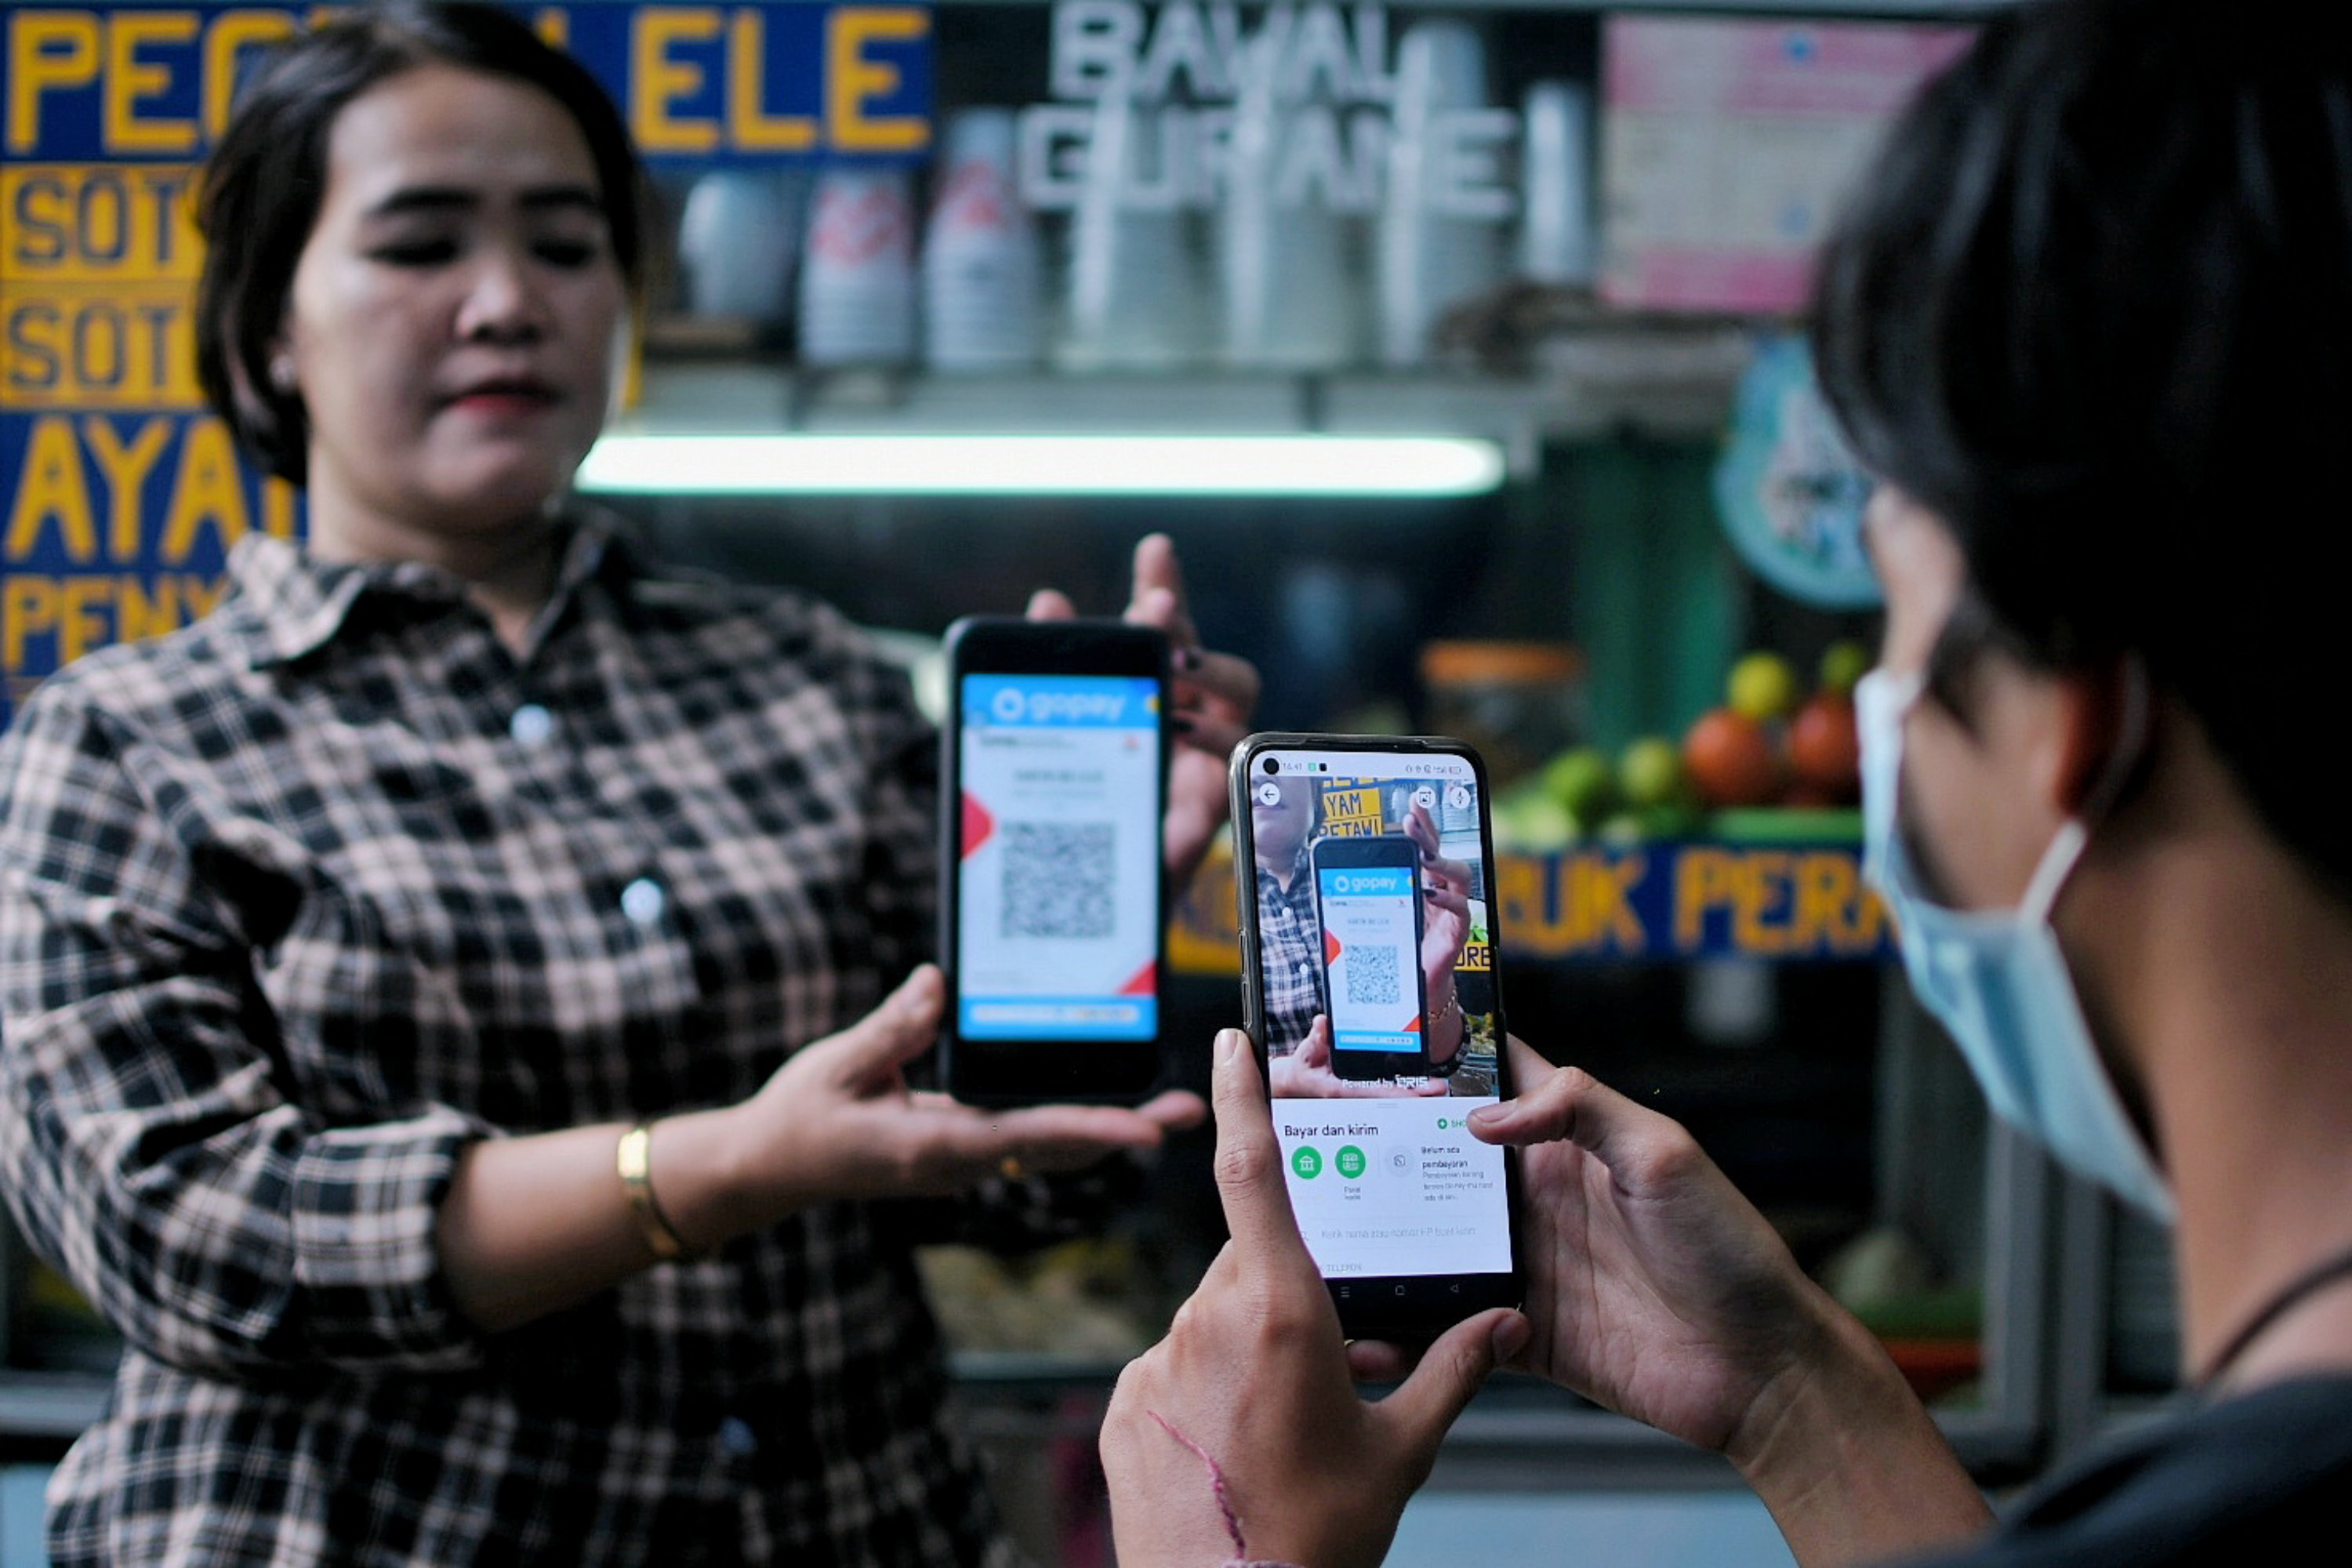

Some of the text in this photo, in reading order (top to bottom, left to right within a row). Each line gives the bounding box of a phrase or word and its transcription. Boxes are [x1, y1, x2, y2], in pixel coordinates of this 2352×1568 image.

[6, 8, 931, 152] PEC ELE
[12, 174, 194, 270] SOT
[8, 302, 185, 392] SOT
[2, 574, 231, 673] PENY
[1031, 688, 1127, 722] gopay
[1322, 791, 1362, 817] YAM
[1352, 876, 1397, 892] gopay
[1341, 1077, 1381, 1089] Powered
[1382, 1076, 1394, 1090] by
[1283, 1123, 1379, 1140] Bayar dan kirim
